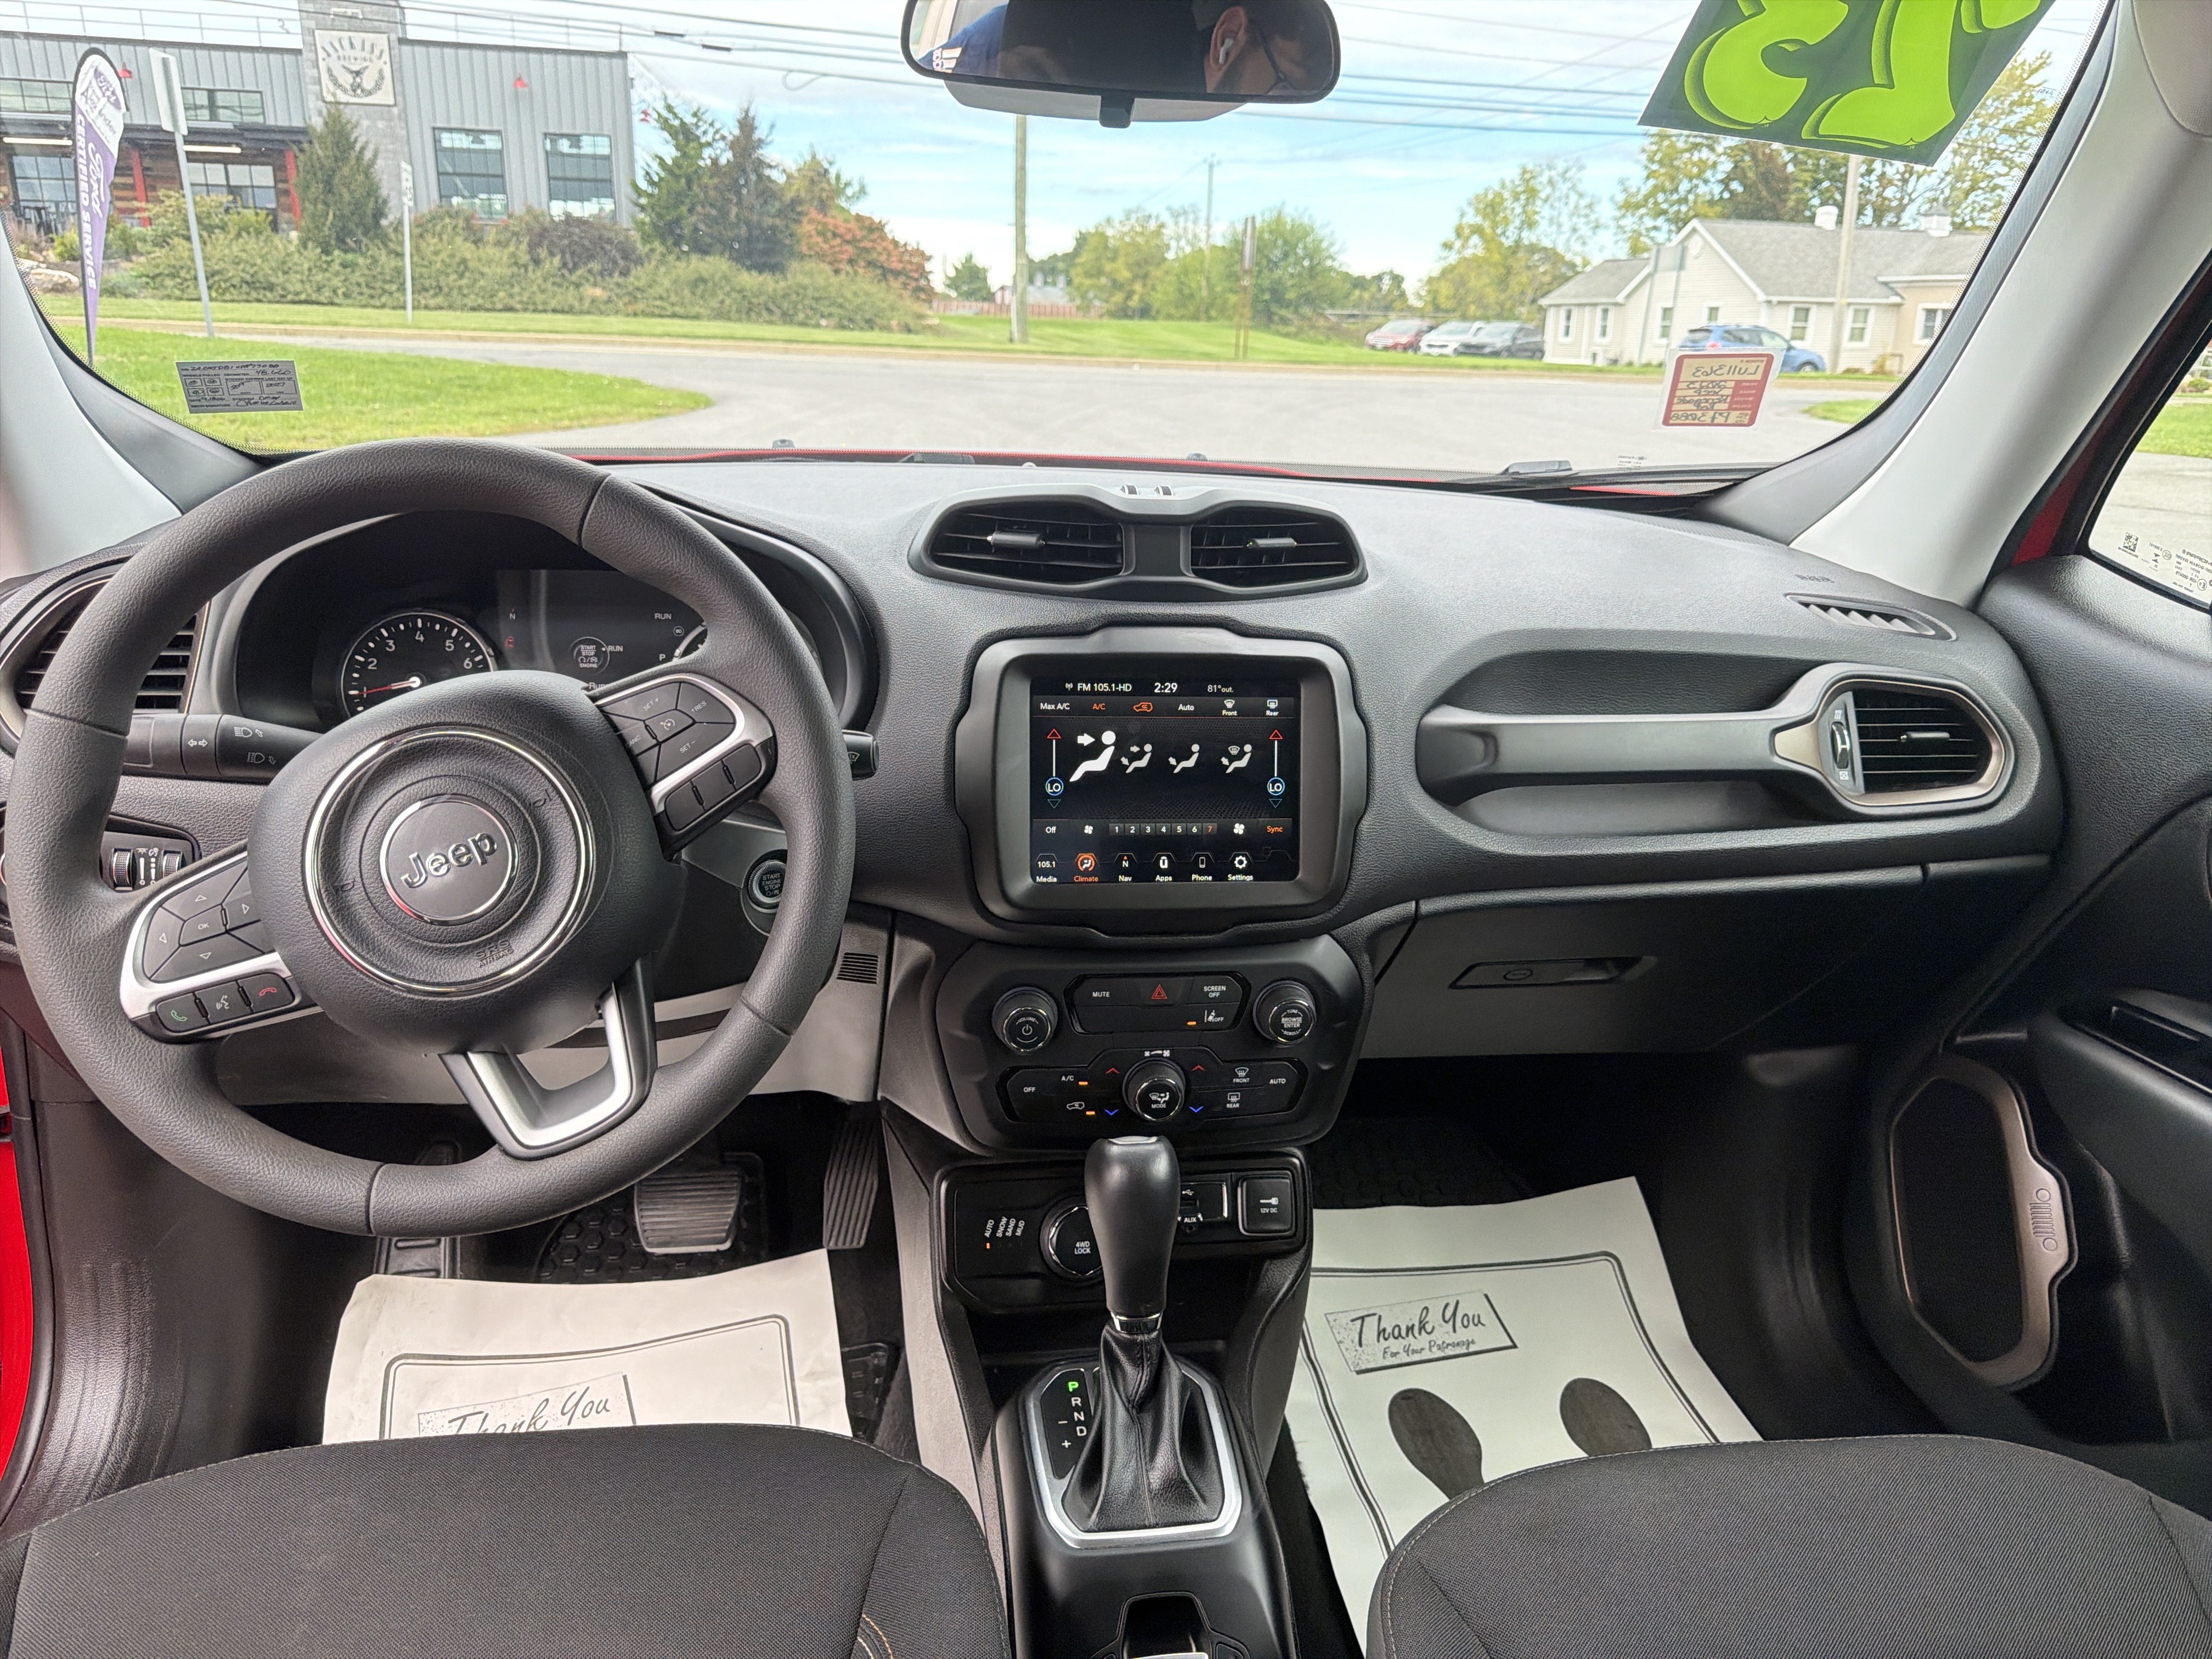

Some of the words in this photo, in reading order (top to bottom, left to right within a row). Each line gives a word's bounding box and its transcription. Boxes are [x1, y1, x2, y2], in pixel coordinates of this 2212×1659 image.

[76, 113, 89, 207] CERTIFIED
[82, 210, 97, 290] SERVICE
[415, 631, 425, 642] 4
[386, 640, 396, 652] 3
[445, 639, 455, 652] 5
[464, 657, 472, 669] 6
[659, 653, 666, 662] P
[368, 658, 377, 670] 2
[1077, 683, 1092, 692] FM
[1093, 683, 1132, 692] 105.1-HD
[1154, 682, 1178, 693] 2:29
[643, 700, 654, 711] SET
[694, 700, 707, 712] RES
[1056, 702, 1070, 711] A/C
[1092, 703, 1106, 711] A/C
[679, 743, 691, 753] SET
[1047, 783, 1062, 792] LO
[1267, 783, 1283, 792] LO
[1266, 825, 1283, 834] Sync
[400, 832, 498, 889] Jeep
[1155, 874, 1172, 883] Apps
[1228, 873, 1254, 882] Settings
[478, 947, 514, 968] AIRBAG
[984, 1219, 995, 1238] AUTO
[996, 1216, 1008, 1238] SNOW
[1005, 1218, 1016, 1237] SAND
[1015, 1220, 1025, 1237] MUD
[1350, 1306, 1436, 1348] Thank
[1441, 1299, 1486, 1334] You
[1382, 1347, 1401, 1360] For
[1403, 1345, 1426, 1358] Your
[1429, 1338, 1477, 1354] Patronage
[1068, 1381, 1079, 1392] P
[560, 1386, 611, 1426] You
[1071, 1397, 1082, 1407] R
[1074, 1410, 1085, 1421] N
[1076, 1426, 1087, 1437] D
